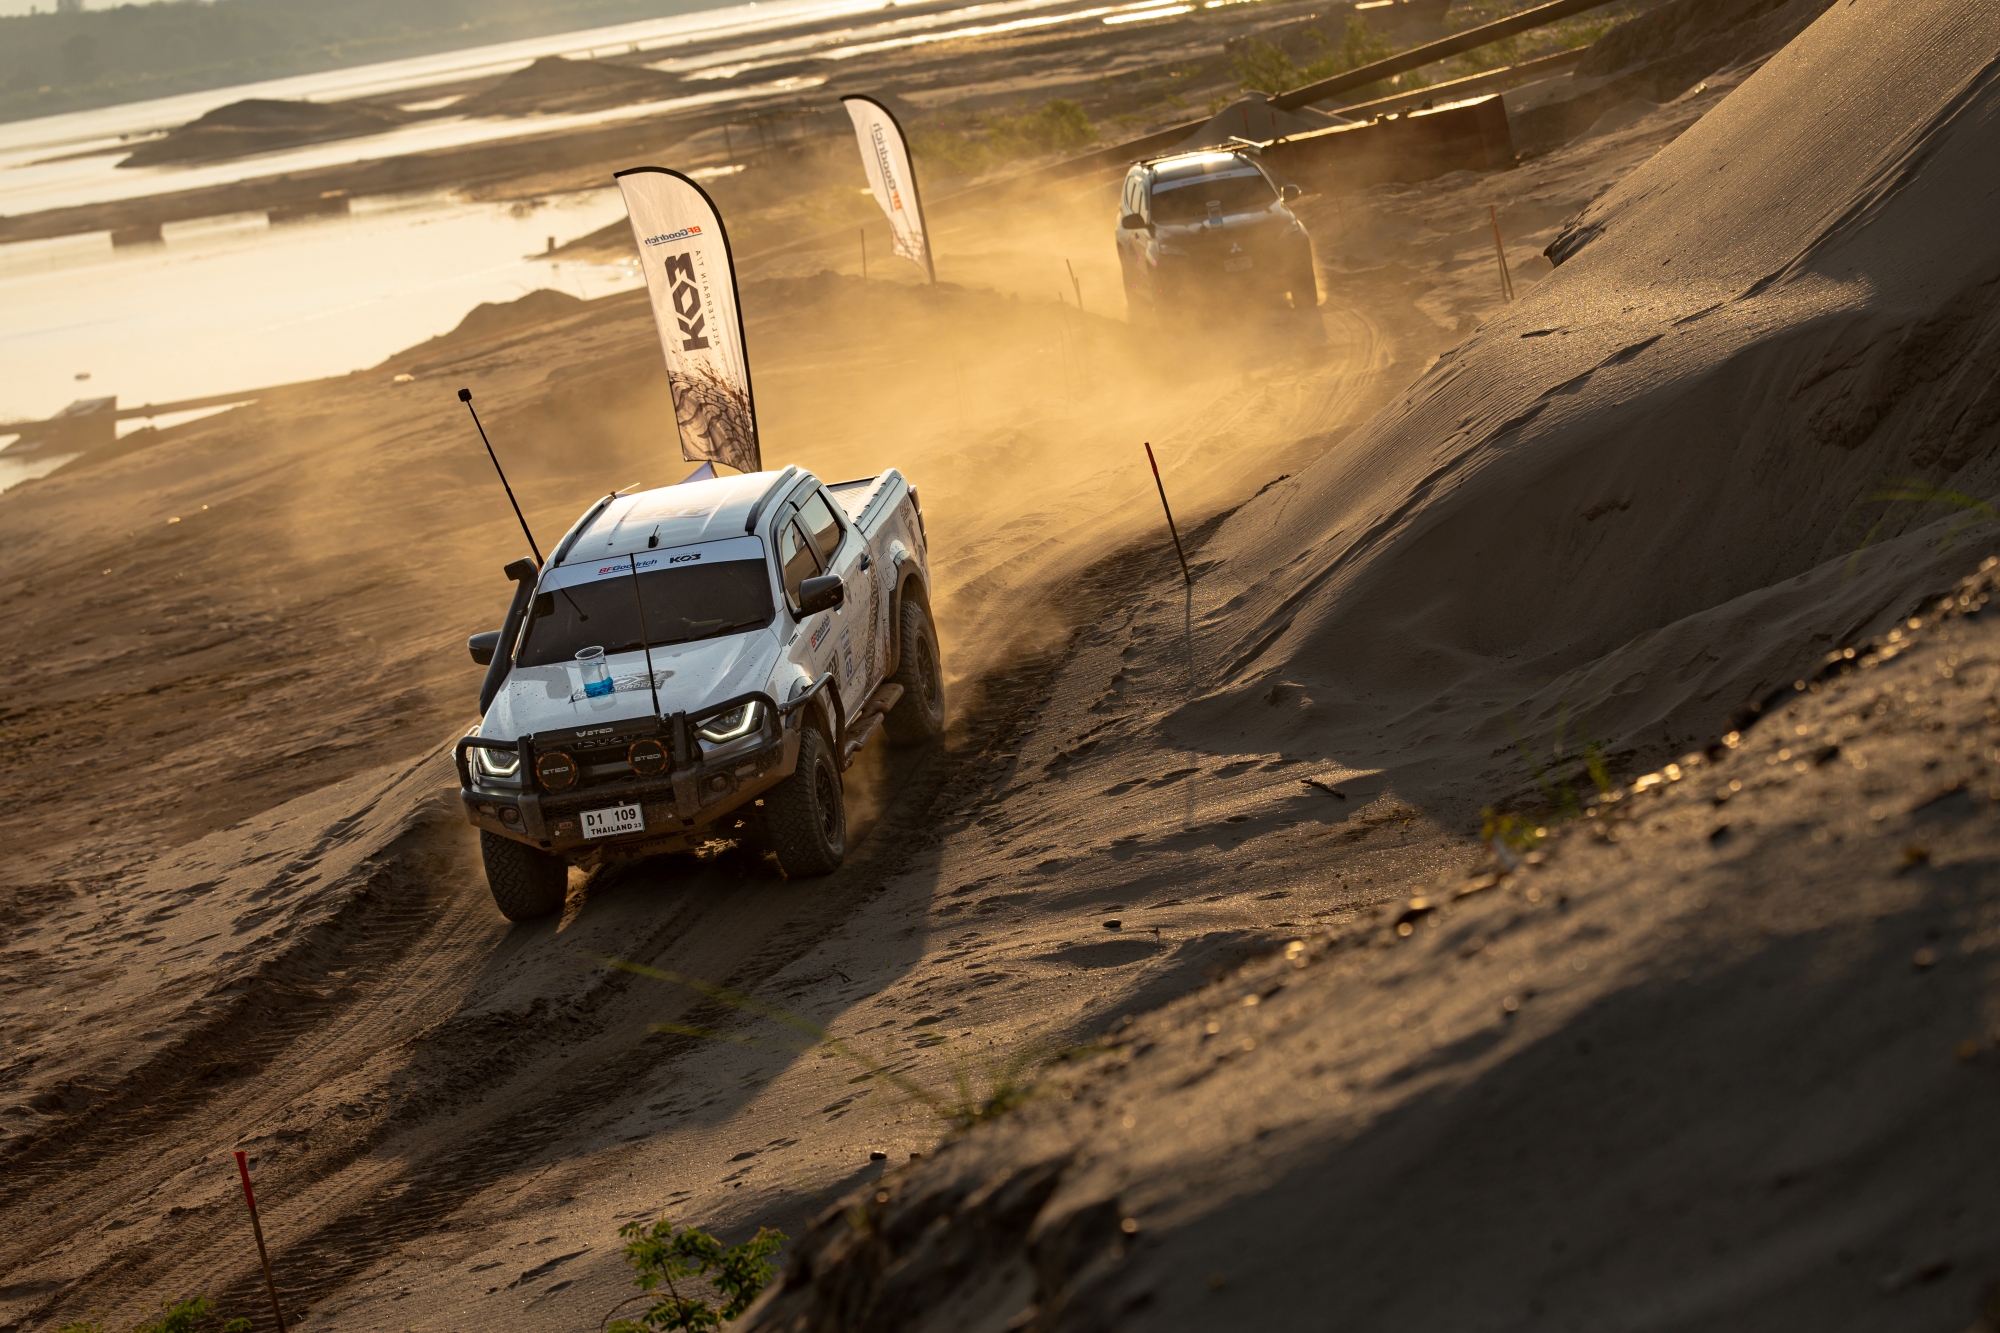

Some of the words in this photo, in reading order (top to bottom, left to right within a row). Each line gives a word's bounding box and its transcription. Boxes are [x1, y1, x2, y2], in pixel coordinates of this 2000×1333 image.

[669, 553, 702, 564] KO3
[587, 727, 614, 736] STEDI
[634, 753, 662, 762] STEDI
[542, 766, 569, 775] STEDI
[586, 812, 603, 827] D1
[614, 808, 637, 822] 109
[591, 823, 633, 836] THAILAND
